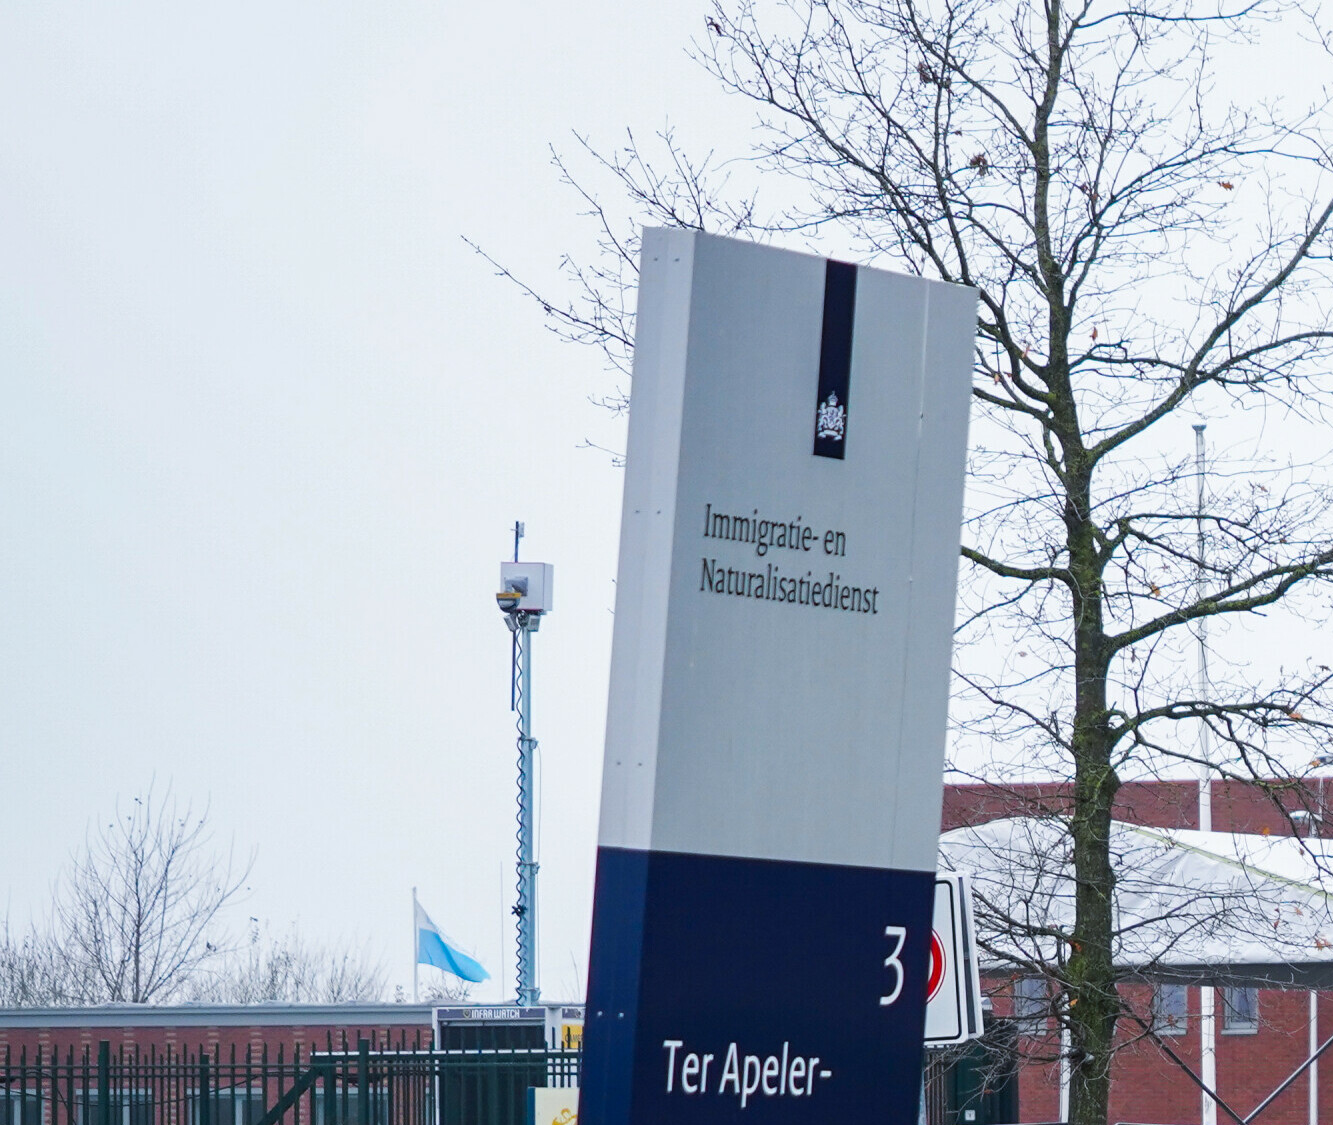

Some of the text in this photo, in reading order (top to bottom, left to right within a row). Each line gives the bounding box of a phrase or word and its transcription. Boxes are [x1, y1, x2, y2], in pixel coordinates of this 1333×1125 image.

[703, 503, 847, 557] Immigratie- en
[700, 557, 880, 614] Naturalisatiedienst
[879, 925, 907, 1006] 3
[663, 1040, 832, 1109] Ter Apeler-
